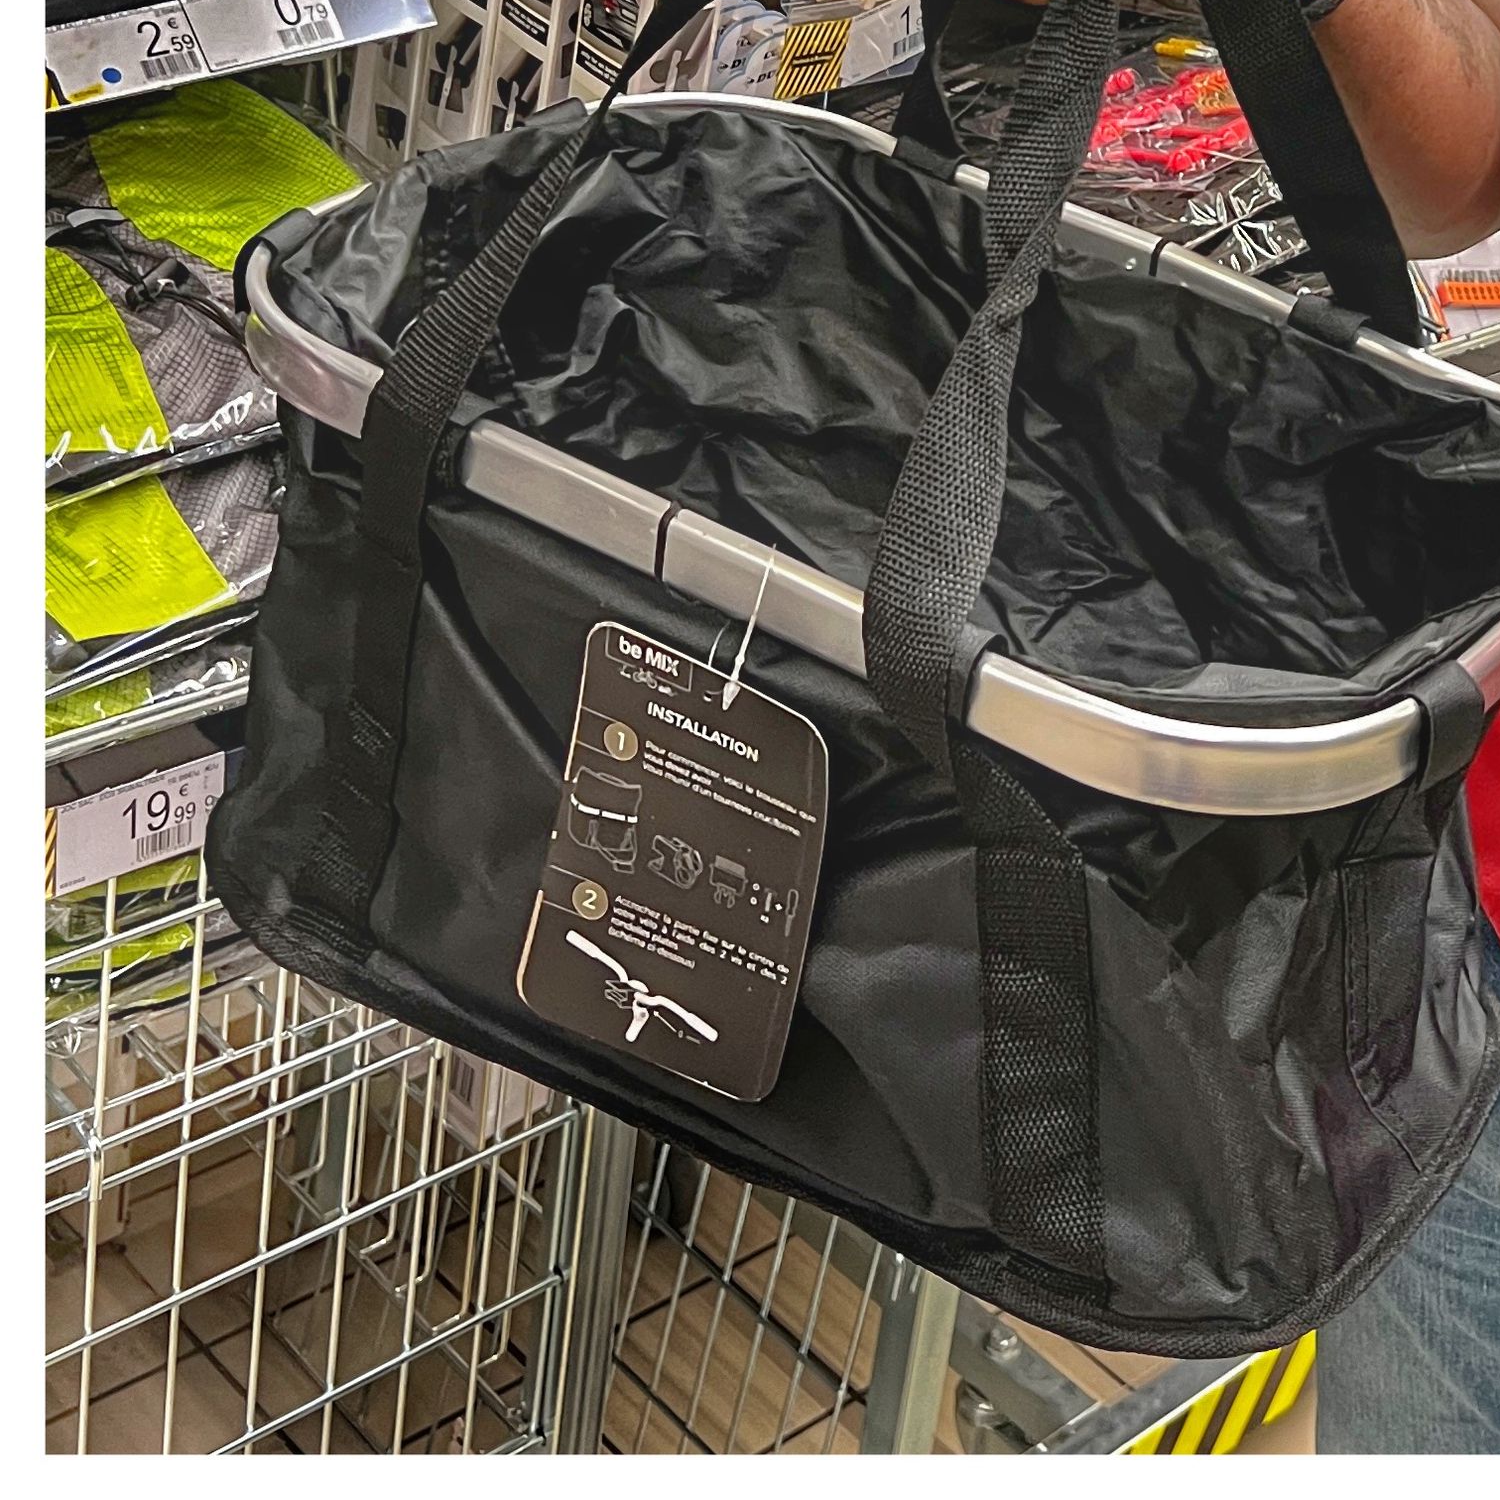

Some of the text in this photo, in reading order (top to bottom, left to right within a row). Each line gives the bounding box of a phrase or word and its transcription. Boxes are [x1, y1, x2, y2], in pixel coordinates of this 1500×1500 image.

[304, 2, 329, 21] 79
[137, 20, 170, 57] 2
[171, 34, 195, 53] 59
[618, 635, 680, 677] be MIX
[618, 731, 625, 751] 1
[647, 701, 760, 763] INSTALLATION
[122, 790, 170, 840] 19
[174, 801, 196, 824] 99
[582, 889, 598, 910] 2
[780, 975, 788, 986] 2
